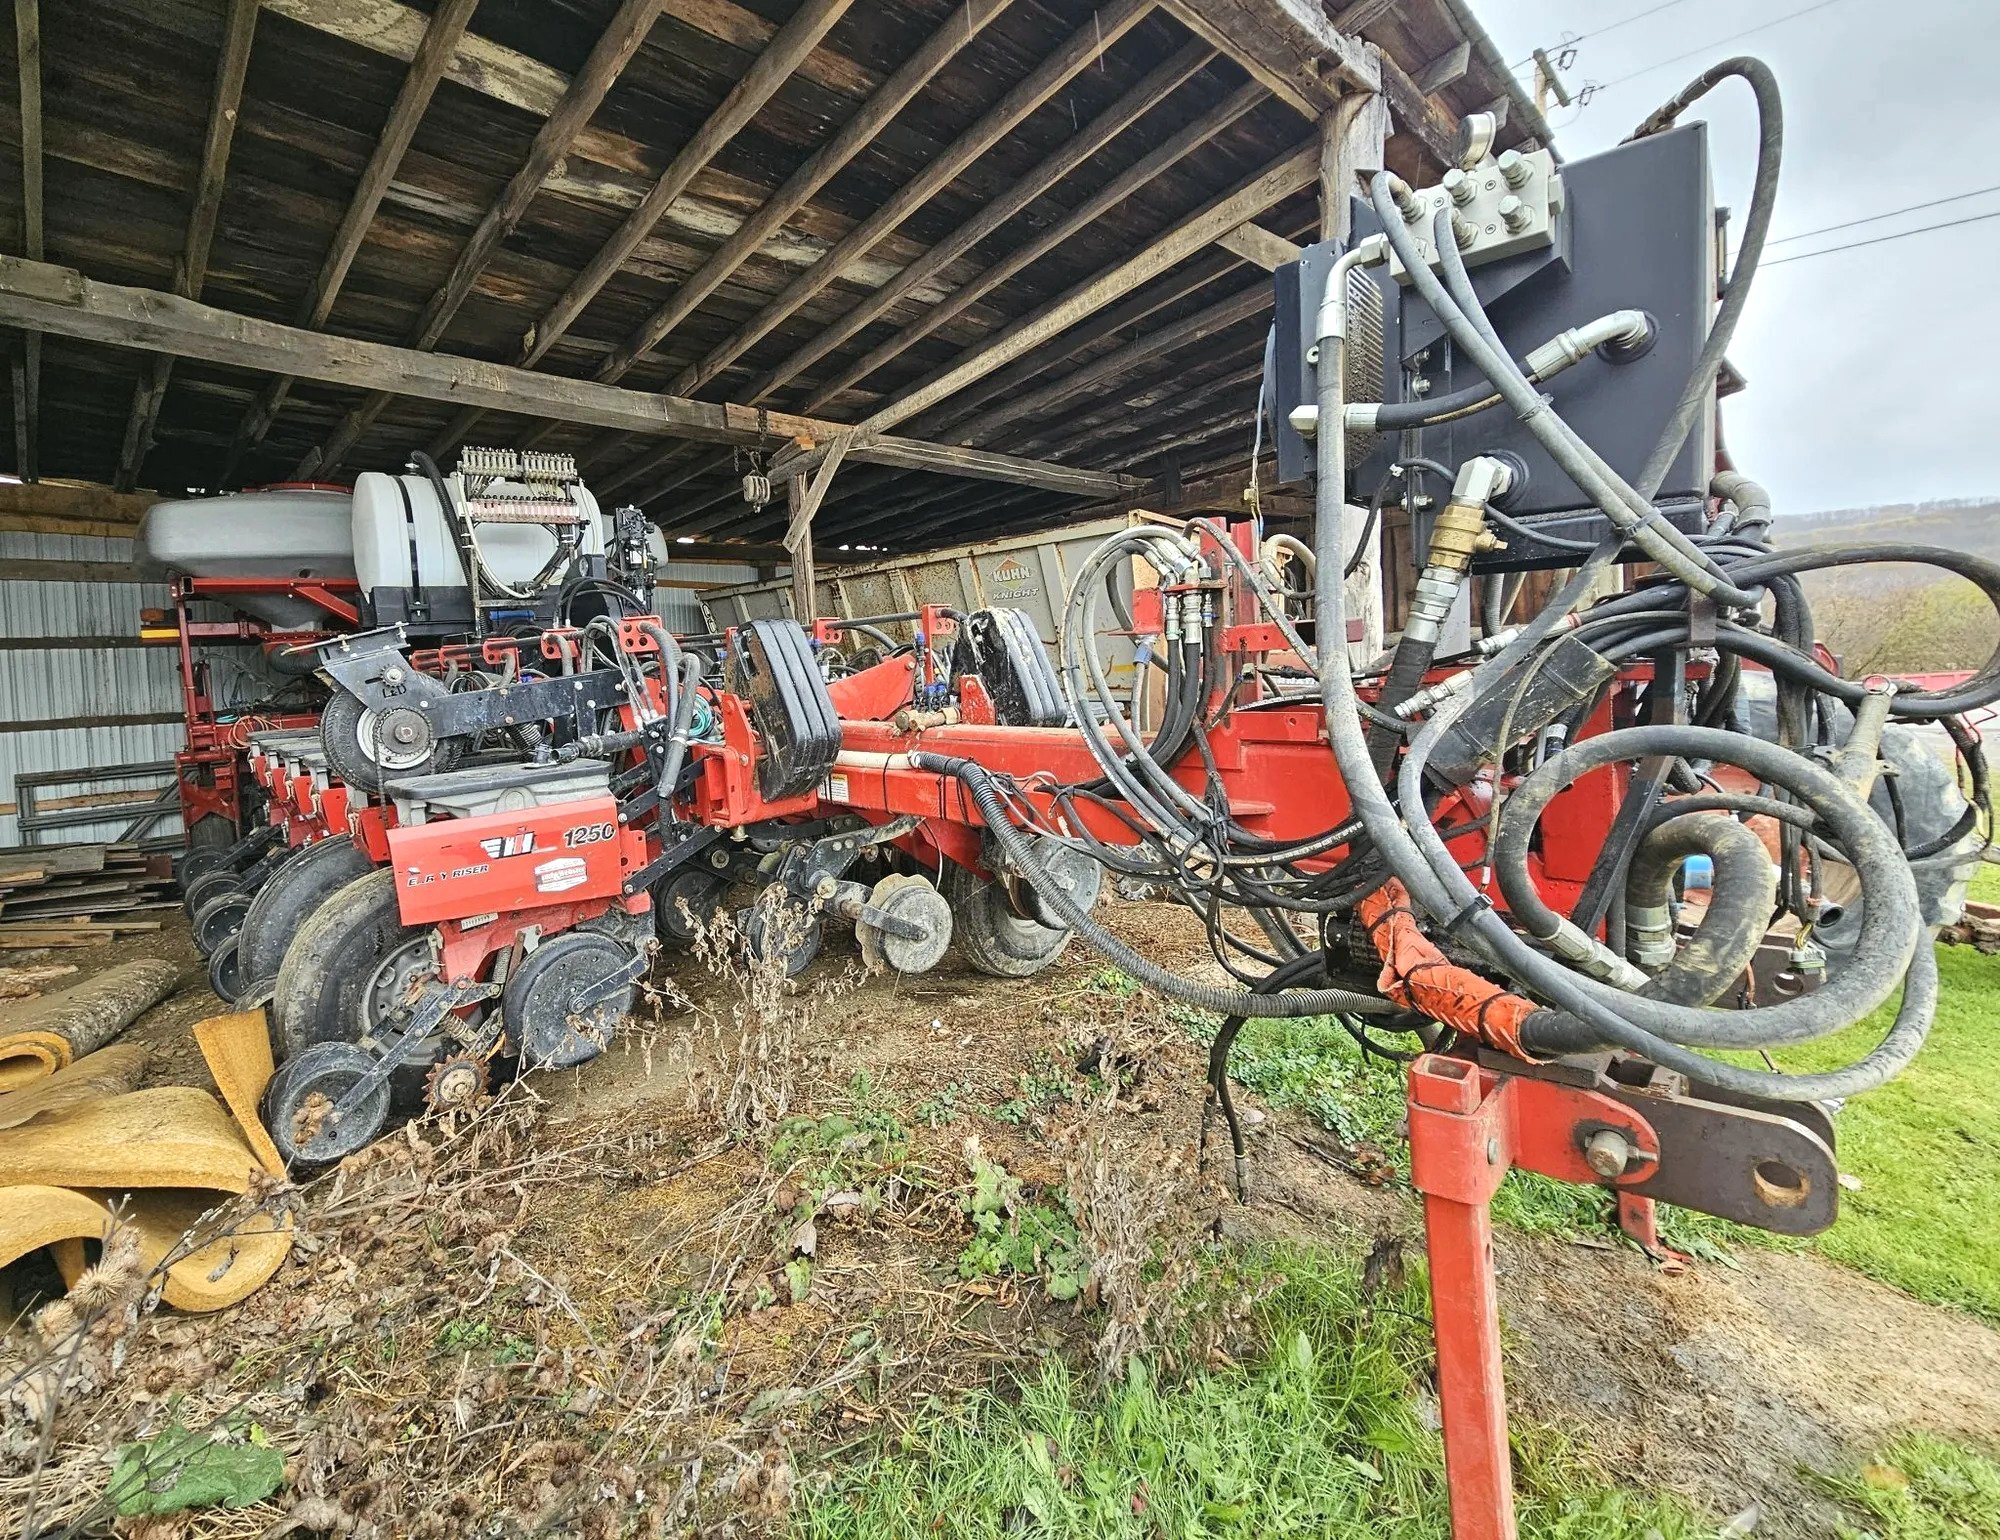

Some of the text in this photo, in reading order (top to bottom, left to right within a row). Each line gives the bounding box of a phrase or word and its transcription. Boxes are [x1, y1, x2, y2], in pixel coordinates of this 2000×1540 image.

[992, 566, 1030, 582] KUHN
[992, 588, 1039, 600] KNIGHT
[563, 822, 617, 848] 1250
[452, 864, 489, 878] RISER
